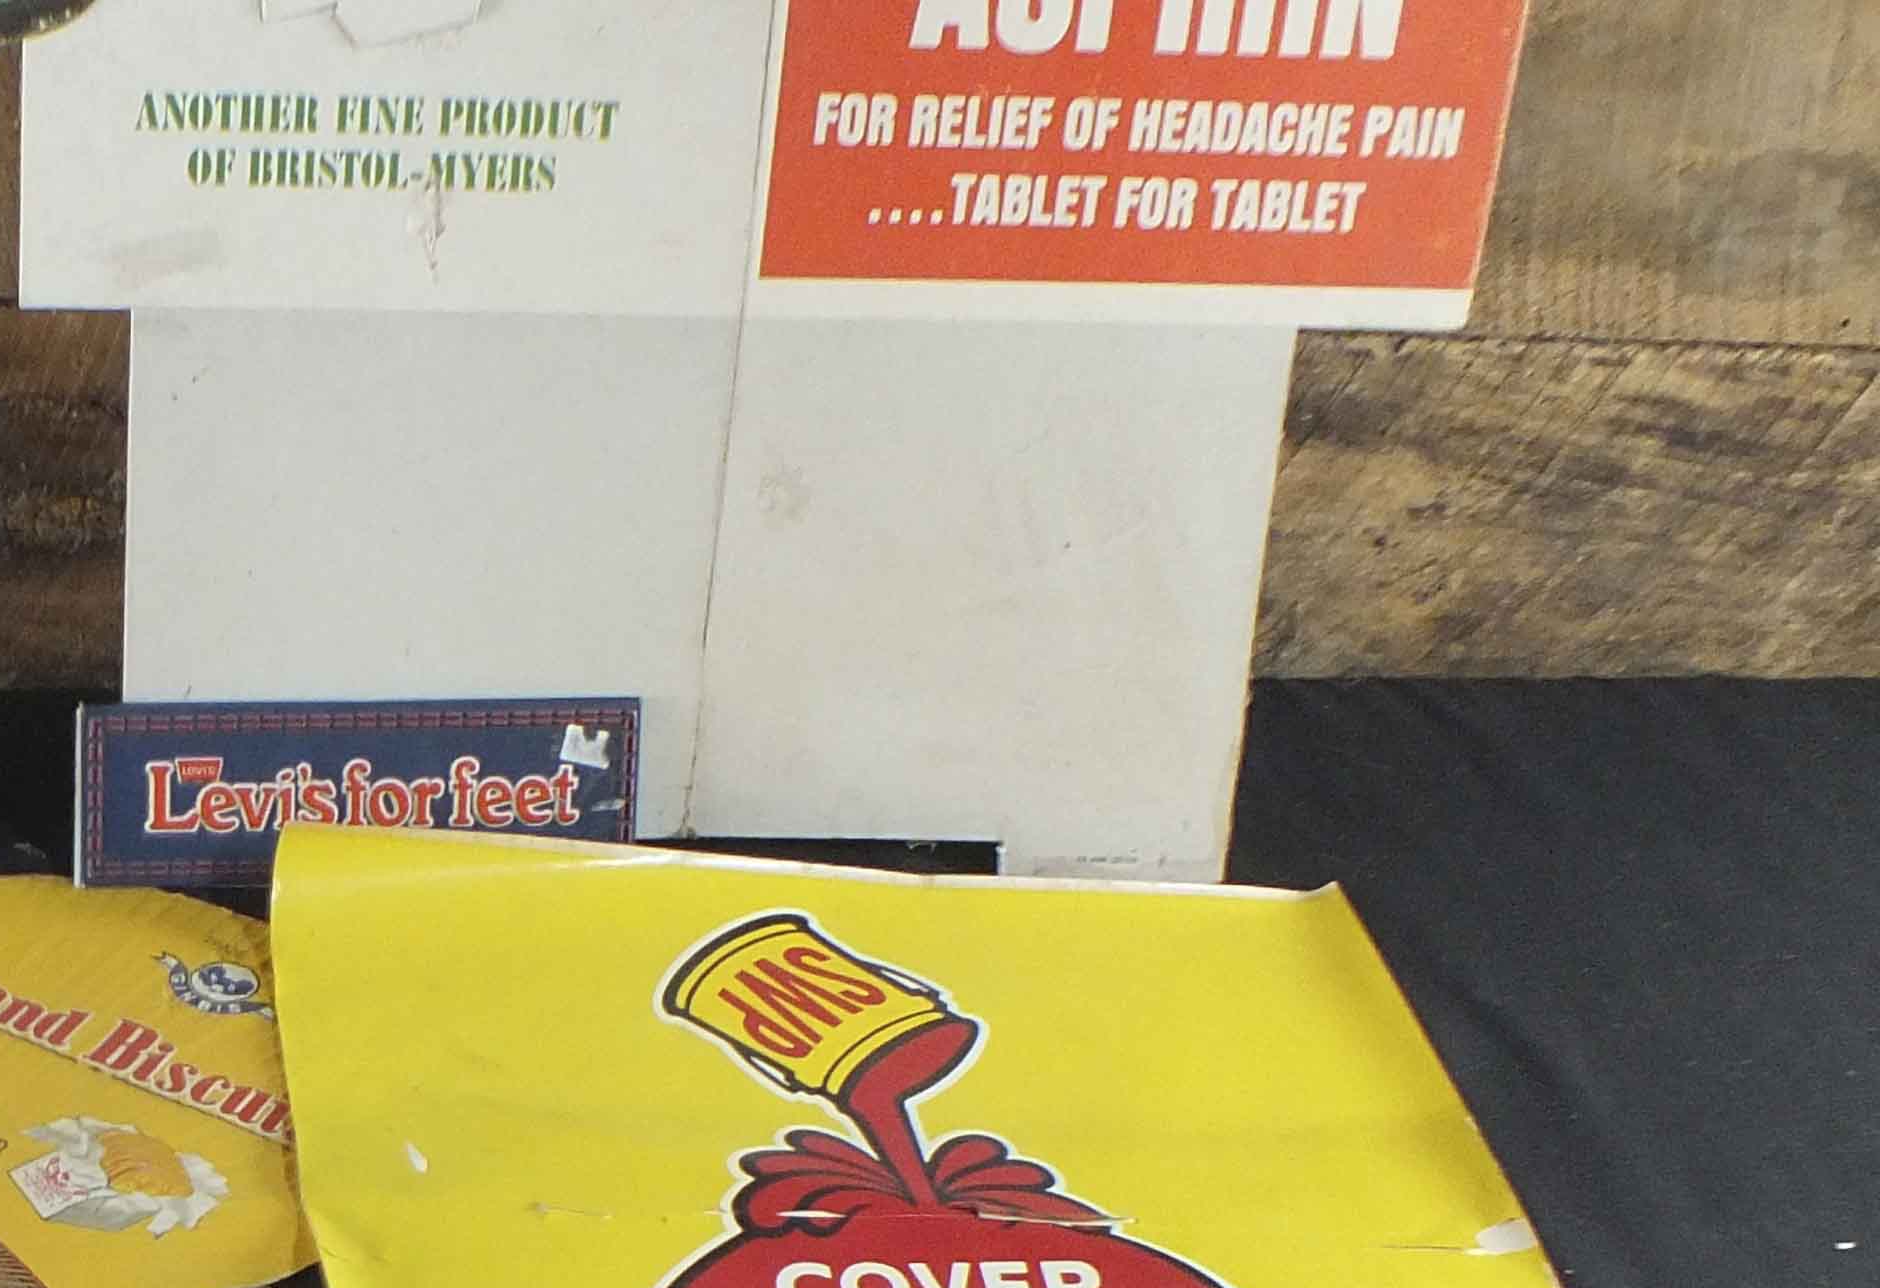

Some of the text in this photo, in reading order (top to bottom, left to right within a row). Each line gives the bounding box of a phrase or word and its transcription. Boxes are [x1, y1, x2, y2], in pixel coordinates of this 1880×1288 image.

[134, 90, 622, 142] ANOTHER FINE PRODUCT
[813, 91, 1466, 160] FOR RELIEF OF HEADACHE PAIN
[186, 147, 558, 193] OF BRISTOL-MYERS
[1113, 176, 1197, 230] FOR
[1210, 178, 1367, 234] TABLET
[343, 757, 446, 828] for
[450, 757, 580, 828] feet
[717, 946, 887, 1059] SWP
